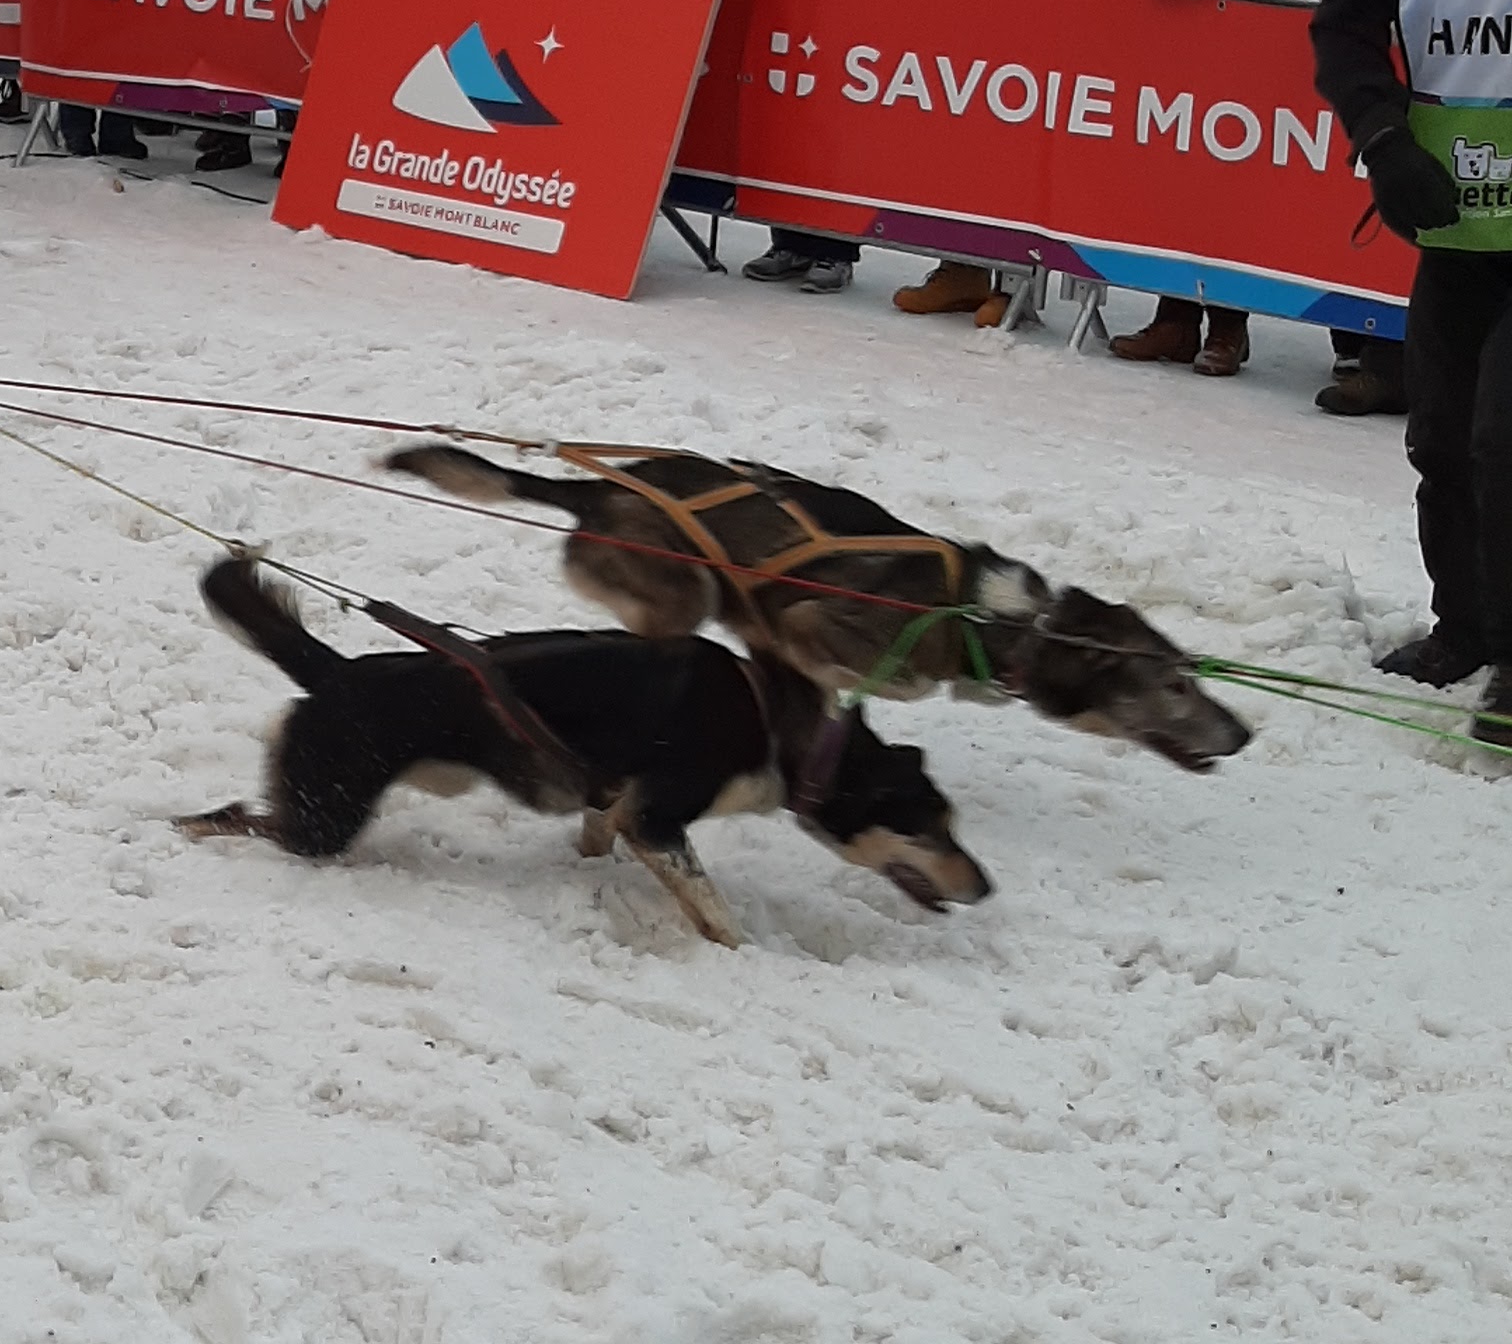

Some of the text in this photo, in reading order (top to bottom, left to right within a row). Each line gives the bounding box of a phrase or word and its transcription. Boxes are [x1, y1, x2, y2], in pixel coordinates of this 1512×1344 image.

[840, 44, 1366, 179] SAVOIE MON
[347, 132, 577, 209] la Grande Odyssée
[387, 196, 522, 236] SAVOIE MONT BLANC
